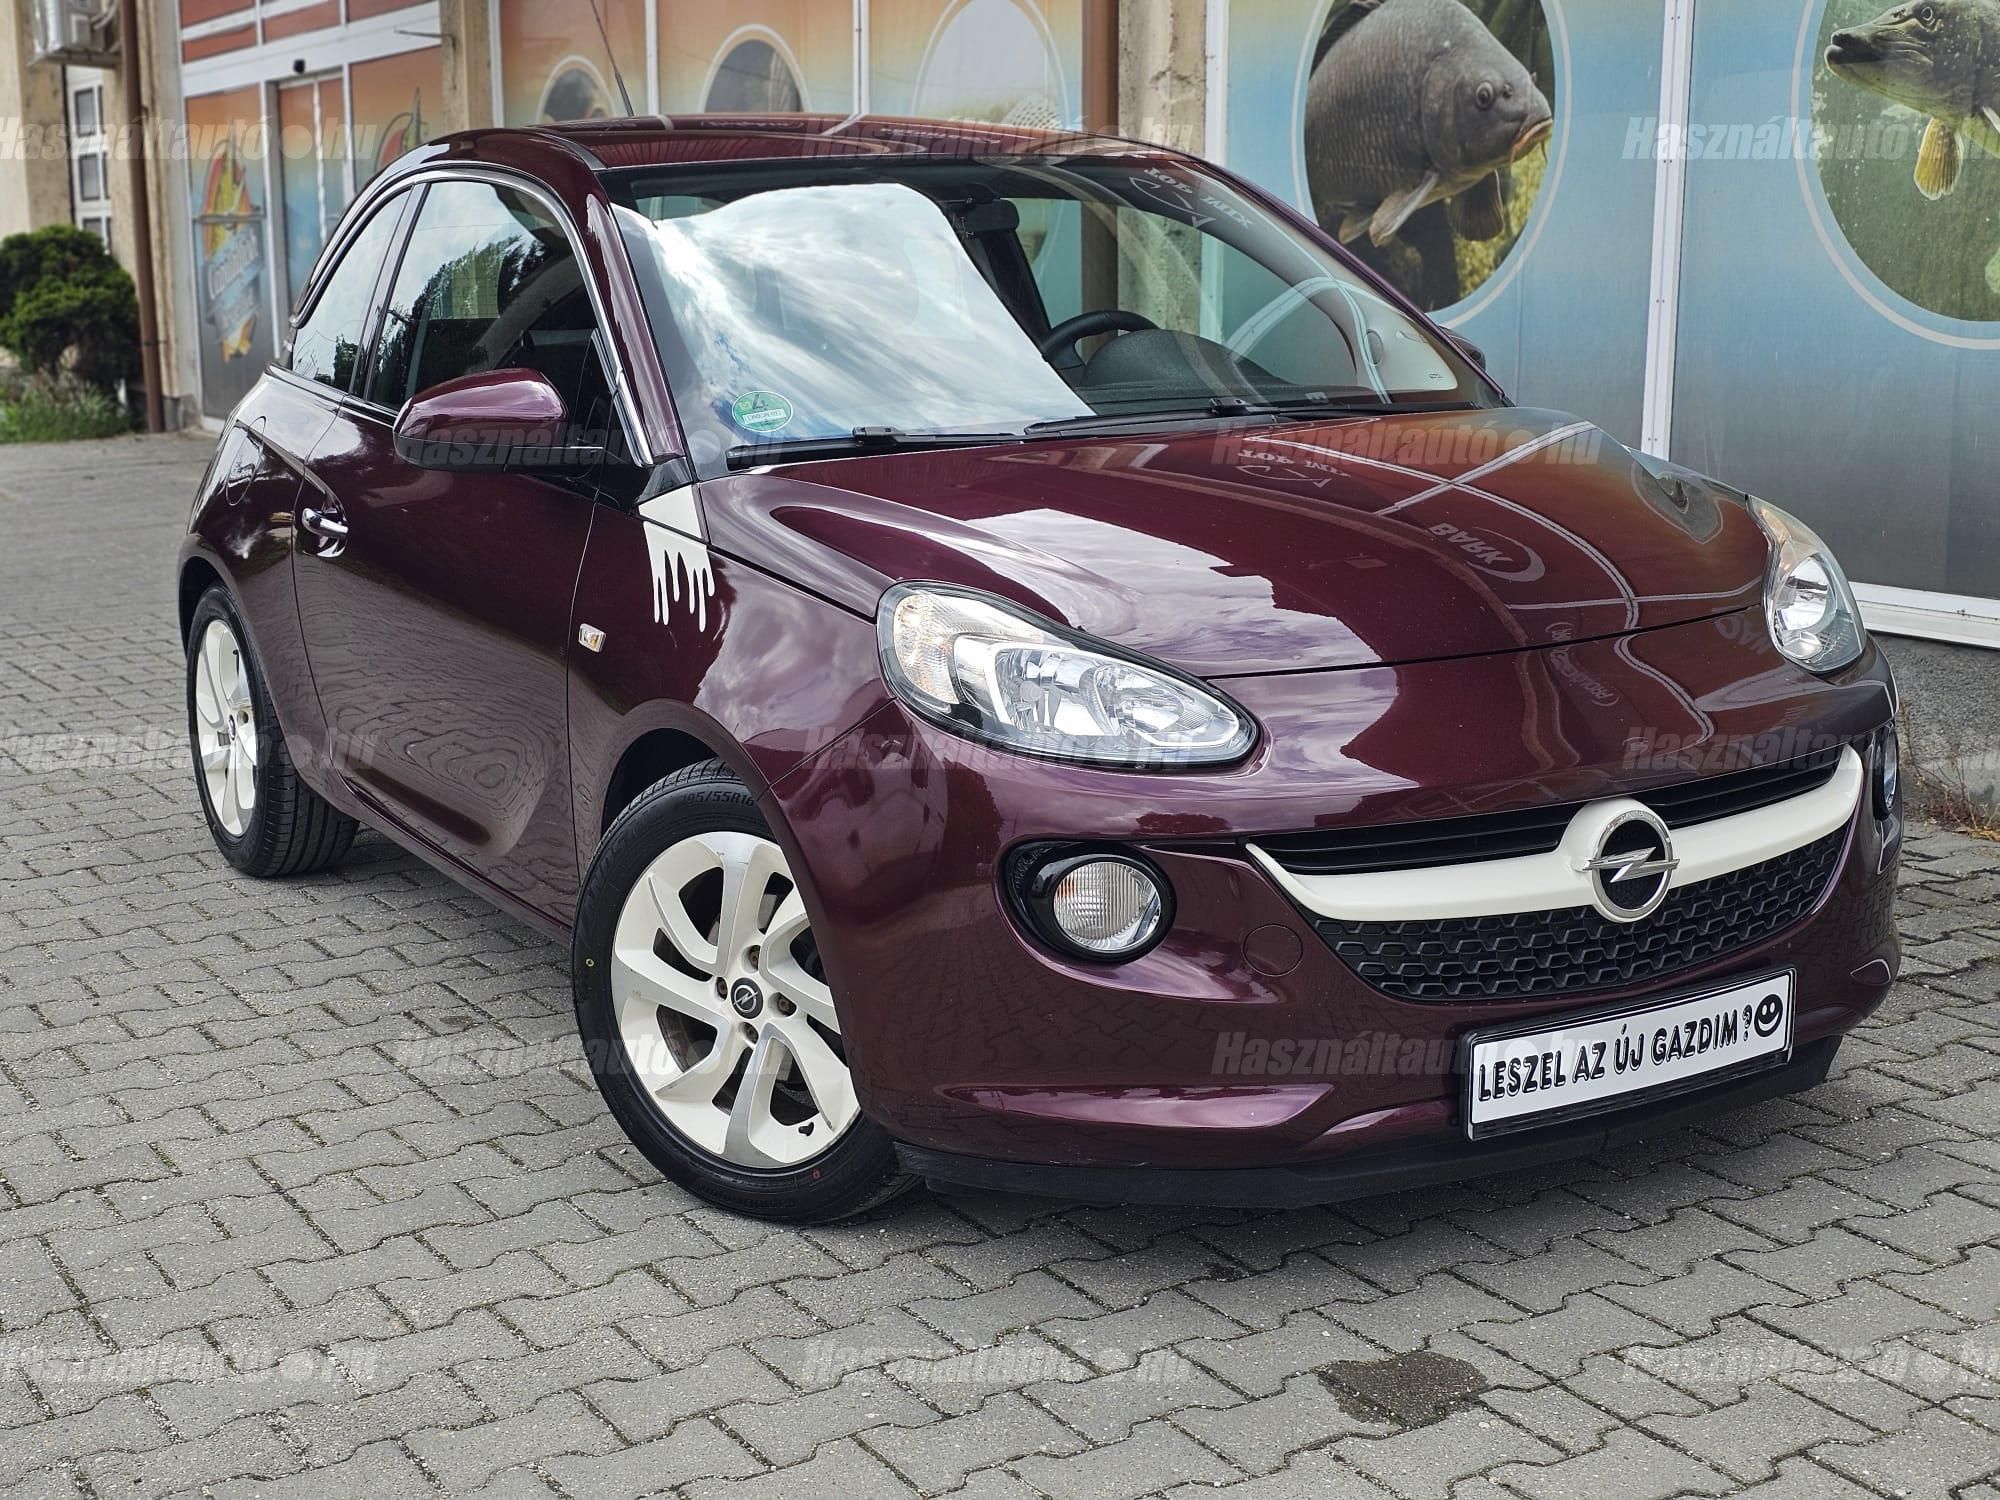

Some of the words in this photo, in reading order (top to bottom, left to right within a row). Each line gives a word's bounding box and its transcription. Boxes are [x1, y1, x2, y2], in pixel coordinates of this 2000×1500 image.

[1478, 1049, 1566, 1102] LESZEL
[1572, 1041, 1607, 1083] AZ
[1613, 1023, 1645, 1075] ÚJ
